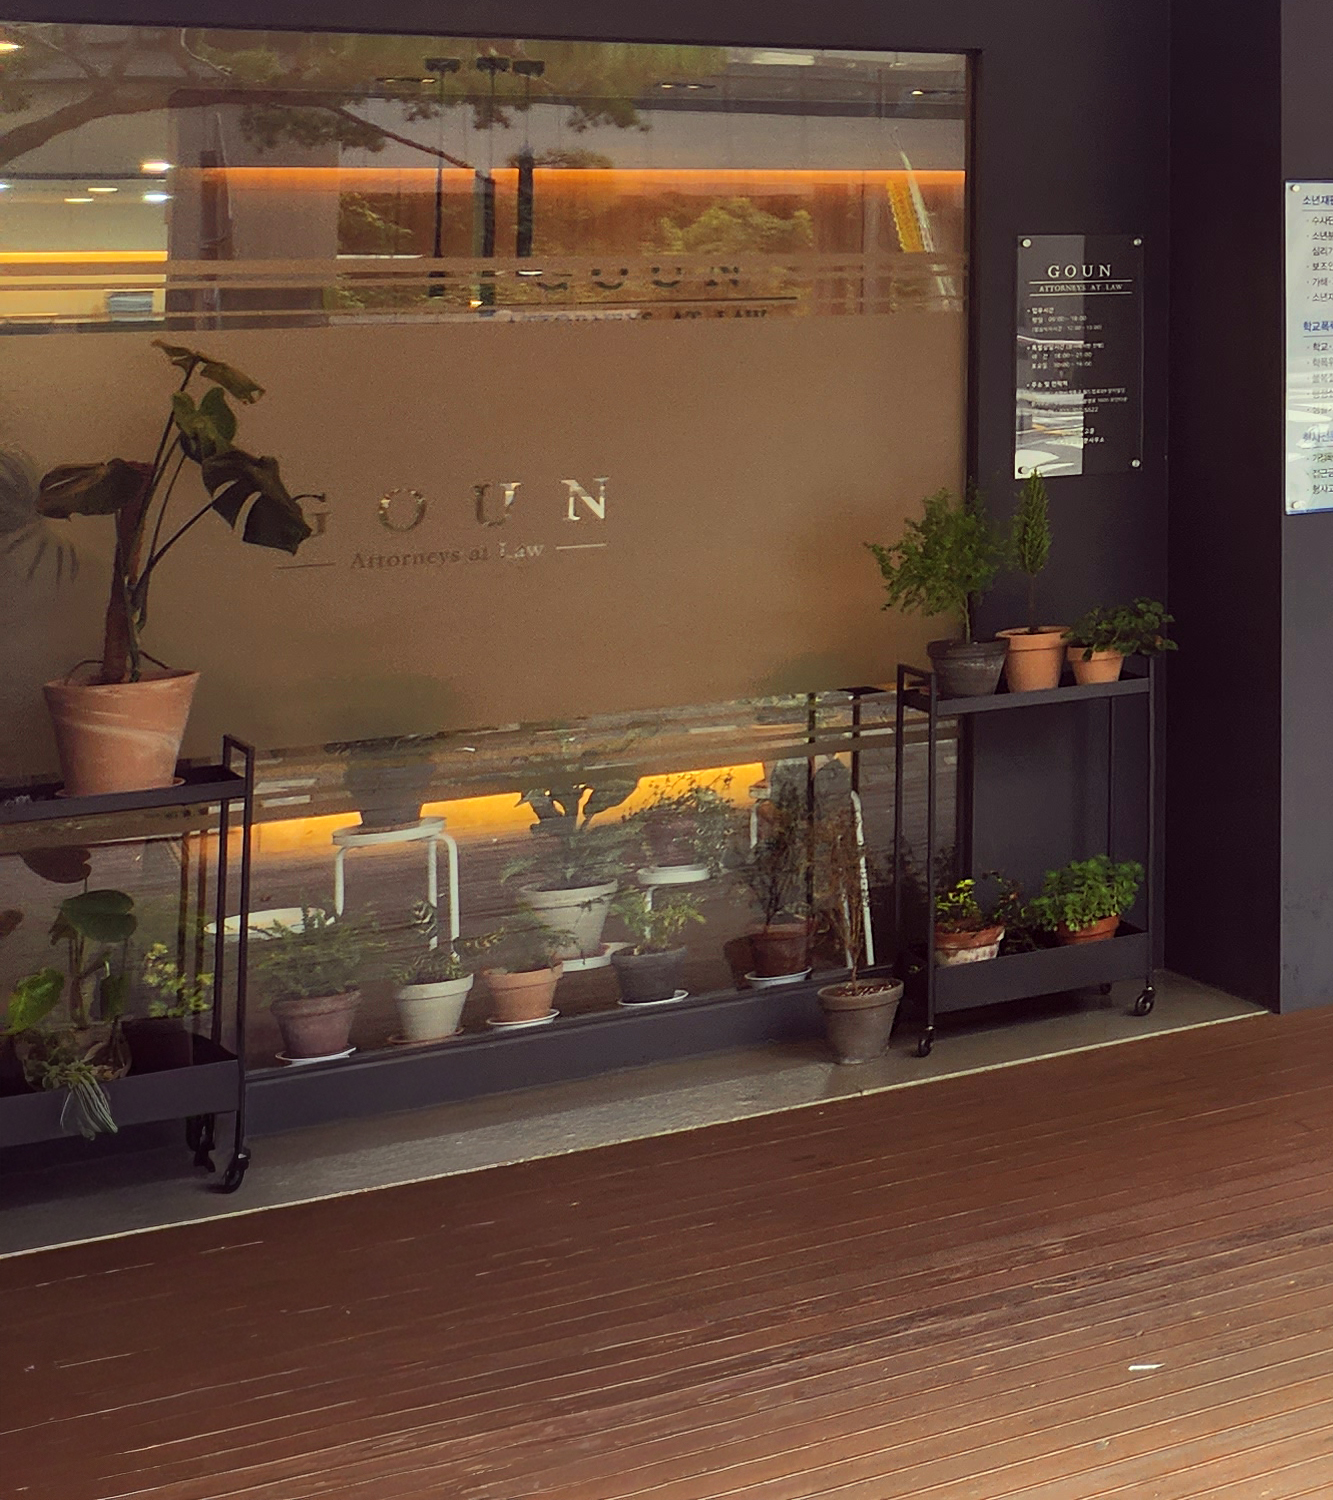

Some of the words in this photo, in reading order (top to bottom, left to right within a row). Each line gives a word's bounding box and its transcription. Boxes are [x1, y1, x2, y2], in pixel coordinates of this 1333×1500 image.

[1047, 264, 1111, 279] GOUN
[1039, 284, 1086, 293] ATTORNEYS
[1105, 283, 1123, 291] LAW
[350, 550, 460, 571] Attorneys
[469, 547, 489, 563] at
[499, 541, 545, 560] Law
